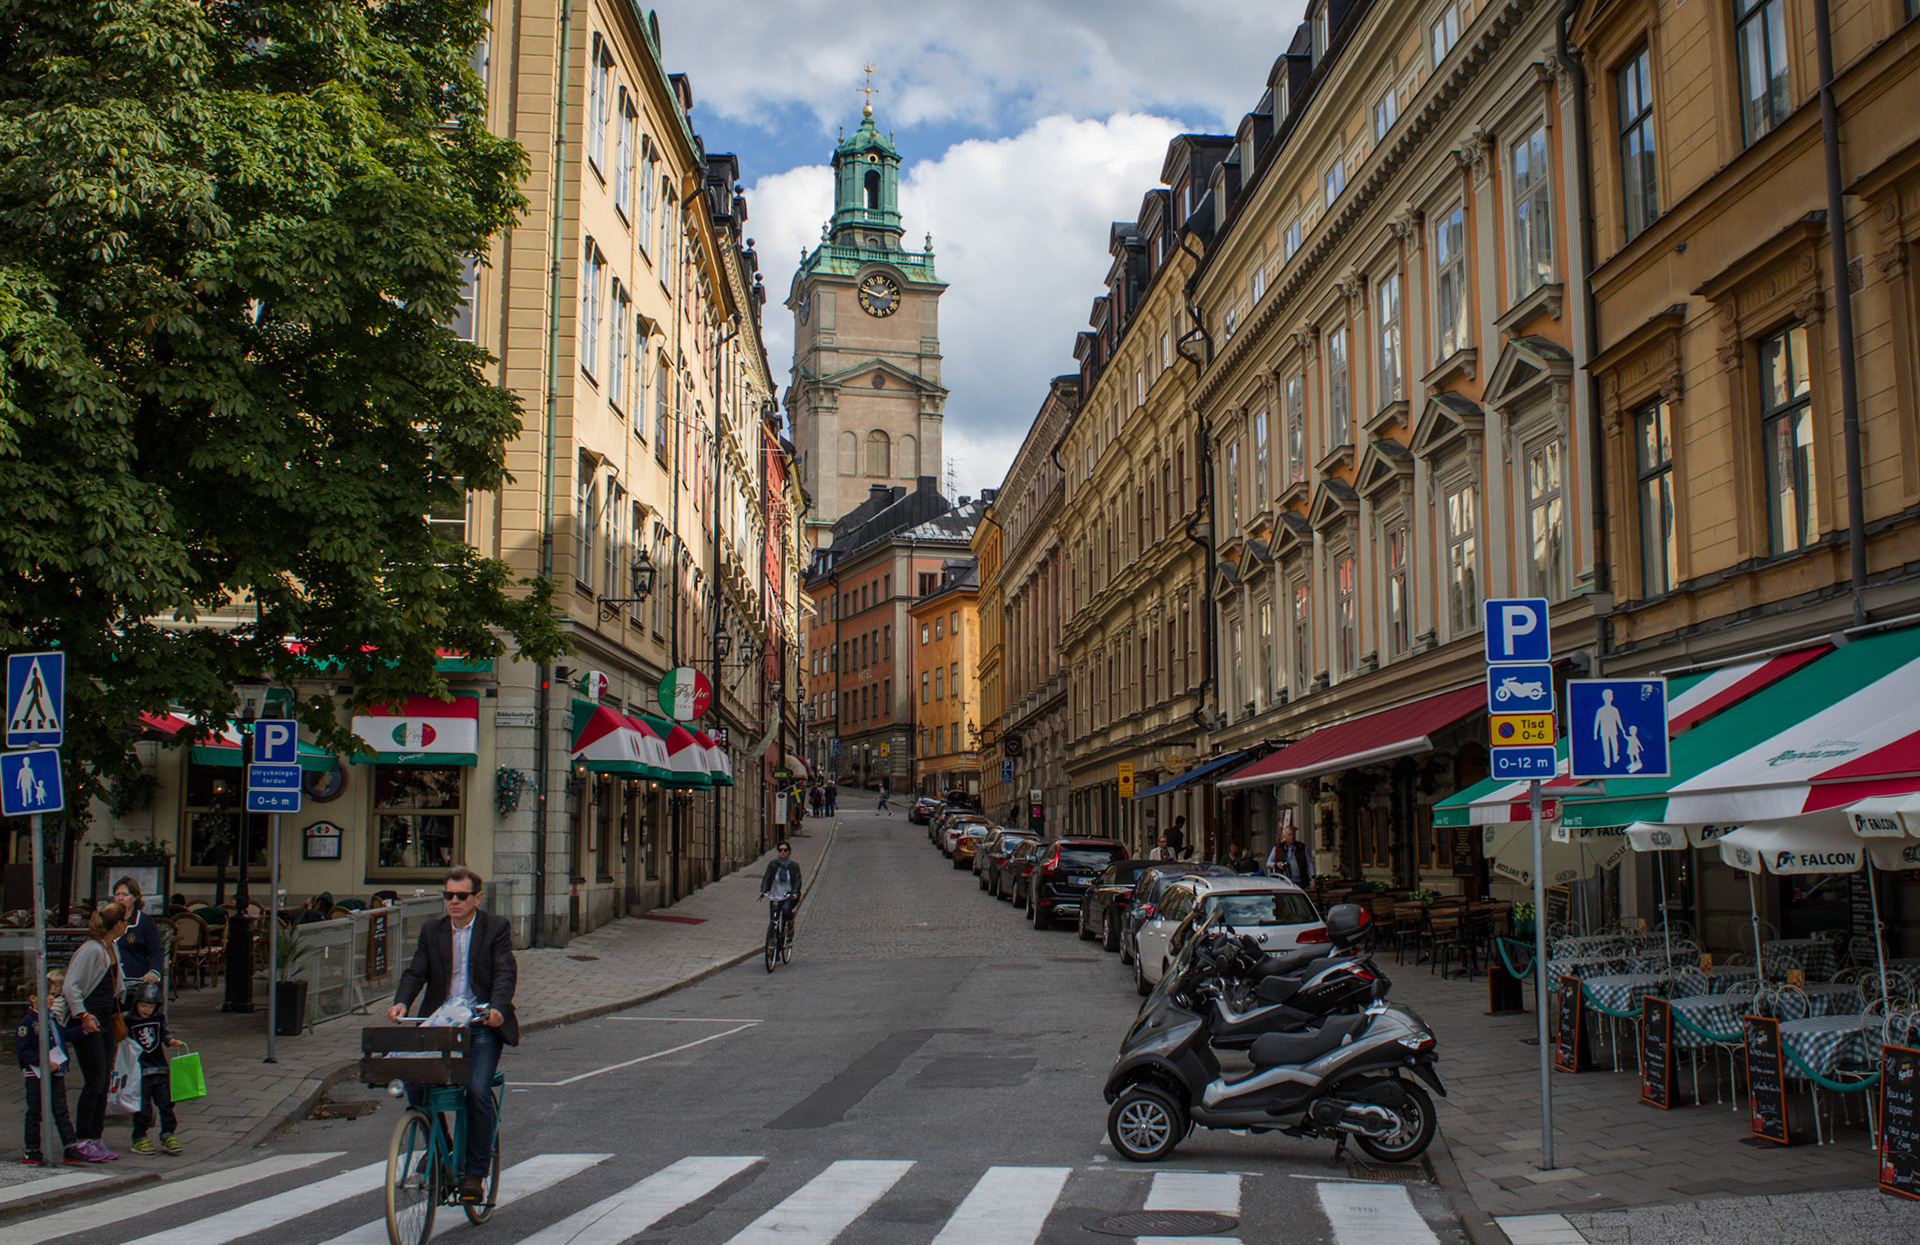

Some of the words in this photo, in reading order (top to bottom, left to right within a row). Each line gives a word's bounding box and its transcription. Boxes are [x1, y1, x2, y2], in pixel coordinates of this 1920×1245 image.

[1501, 605, 1537, 656] P
[1521, 719, 1545, 729] Tisd
[264, 724, 290, 759] P
[1522, 731, 1545, 740] 0-6
[1004, 761, 1010, 769] P
[1499, 757, 1532, 769] 0-12
[1537, 758, 1548, 768] m
[257, 796, 278, 806] 0-6
[281, 798, 290, 806] m
[1868, 818, 1898, 831] FALCON
[1800, 852, 1856, 866] FALCON
